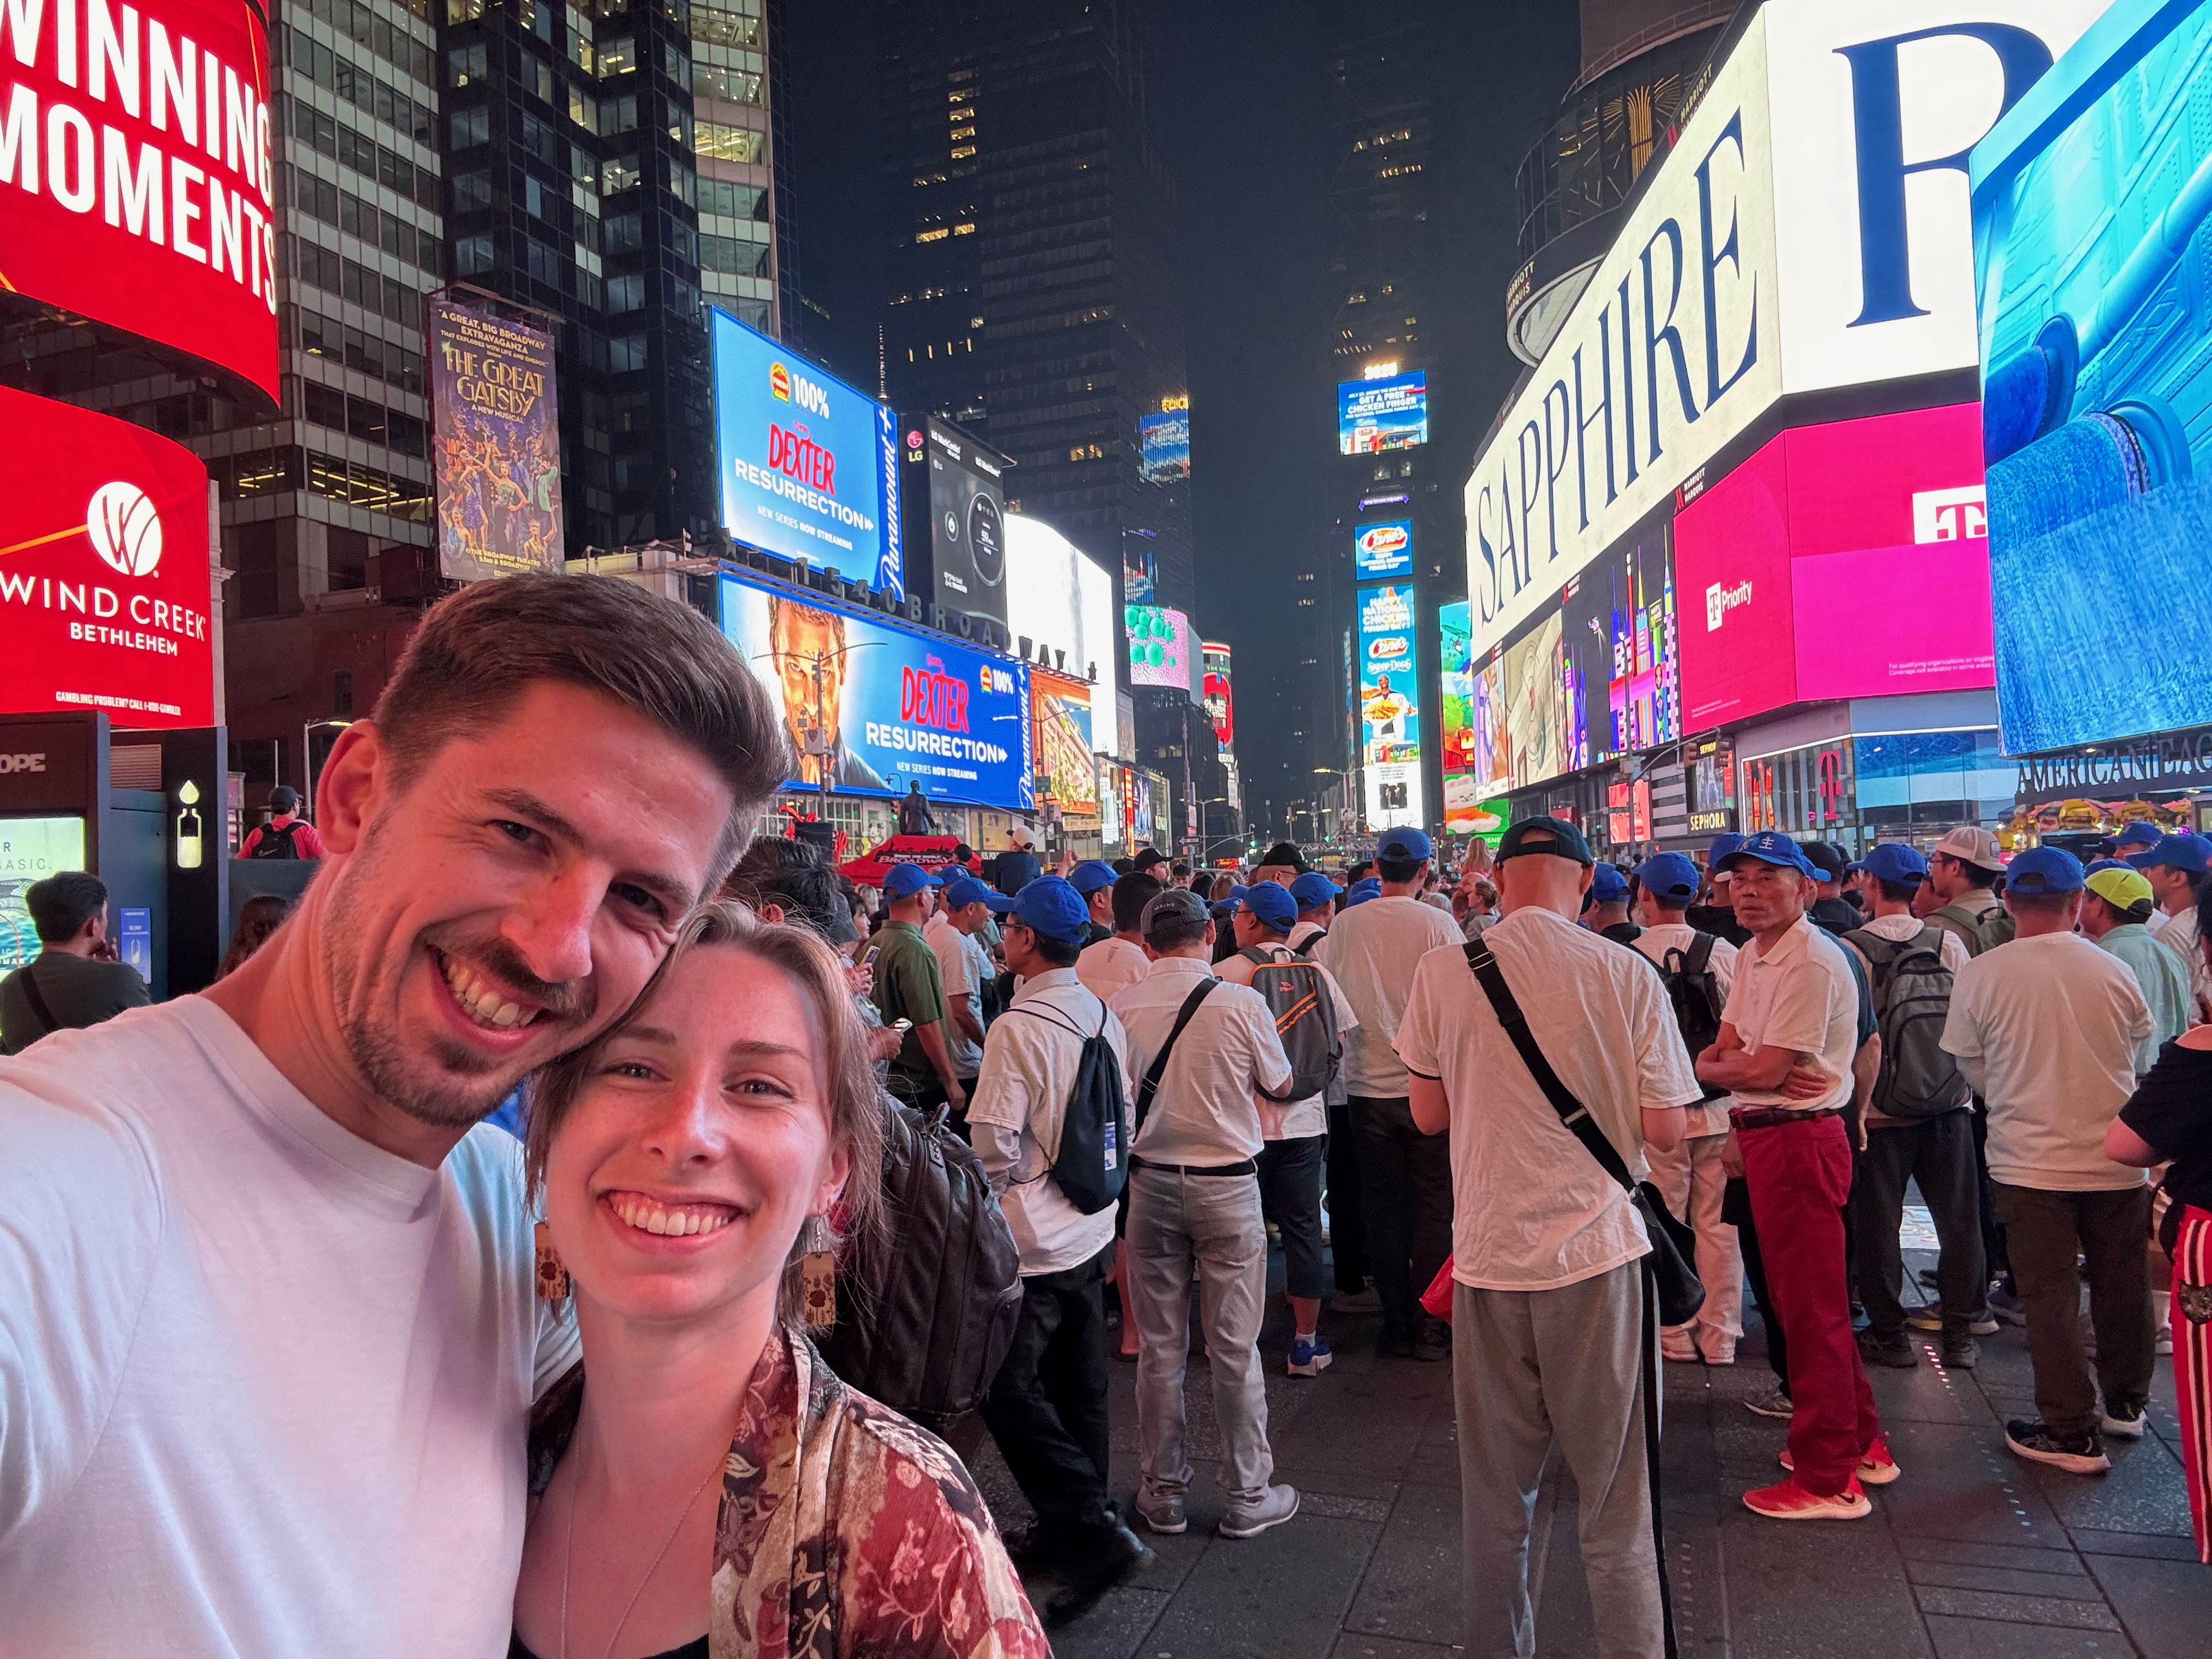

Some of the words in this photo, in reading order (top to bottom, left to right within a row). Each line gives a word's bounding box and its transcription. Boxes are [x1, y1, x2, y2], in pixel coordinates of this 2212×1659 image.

[1680, 63, 1712, 123] MARRIOTT
[1507, 261, 1534, 304] MARRIOTT
[1508, 282, 1530, 316] MARQUIS
[441, 329, 455, 339] THAT
[456, 335, 485, 348] EXPLODES
[486, 343, 500, 352] WITH
[449, 313, 481, 330] GREAT,
[482, 323, 498, 335] BIG
[500, 328, 545, 350] BROADWAY
[461, 326, 528, 354] EXTRAVAGANZA
[441, 341, 478, 378] THE
[483, 359, 545, 397] GREAT
[1479, 105, 1757, 628] SAPPHIRE
[456, 376, 535, 417] GATSBY
[793, 374, 830, 419] 100%
[1347, 402, 1385, 414] CHICKEN
[1386, 396, 1417, 408] FINGER
[1359, 394, 1375, 405] GET
[1376, 394, 1383, 402] A
[1384, 391, 1405, 401] FREE
[478, 406, 493, 416] NEW
[495, 411, 524, 424] MUSICAL
[768, 422, 836, 496] DEXTER
[908, 450, 923, 462] LG
[735, 458, 864, 531] RESURRECTION
[757, 504, 774, 520] NEW
[775, 511, 798, 529] SERIES
[800, 522, 815, 536] NOW
[817, 528, 853, 551] STREAMING
[483, 550, 515, 561] BROADWAY
[0, 571, 119, 618] WIND
[130, 595, 205, 642] CREEK
[1363, 603, 1409, 616] NATIONAL
[1722, 580, 1752, 613] Priority
[1363, 612, 1410, 625] CHICKEN
[71, 622, 178, 657] BETHLEHEM
[1899, 661, 1926, 670] qualifying
[1927, 659, 1965, 667] organizations
[993, 669, 1014, 695] 100%
[55, 691, 93, 704] GAMBLING
[94, 695, 128, 708] PROBLEM?
[129, 698, 144, 710] CALL
[900, 665, 969, 733] DEXTER
[866, 721, 997, 764] RESURRECTION
[1459, 728, 1475, 749] D
[897, 761, 910, 771] NEW
[912, 763, 932, 775] SERIES
[932, 766, 946, 776] NOW
[947, 768, 978, 781] STREAMING
[2017, 741, 2153, 794] AMERICAN
[1690, 812, 1725, 831] SEPHORA
[4, 842, 11, 852] R
[1154, 902, 1176, 911] MAINE
